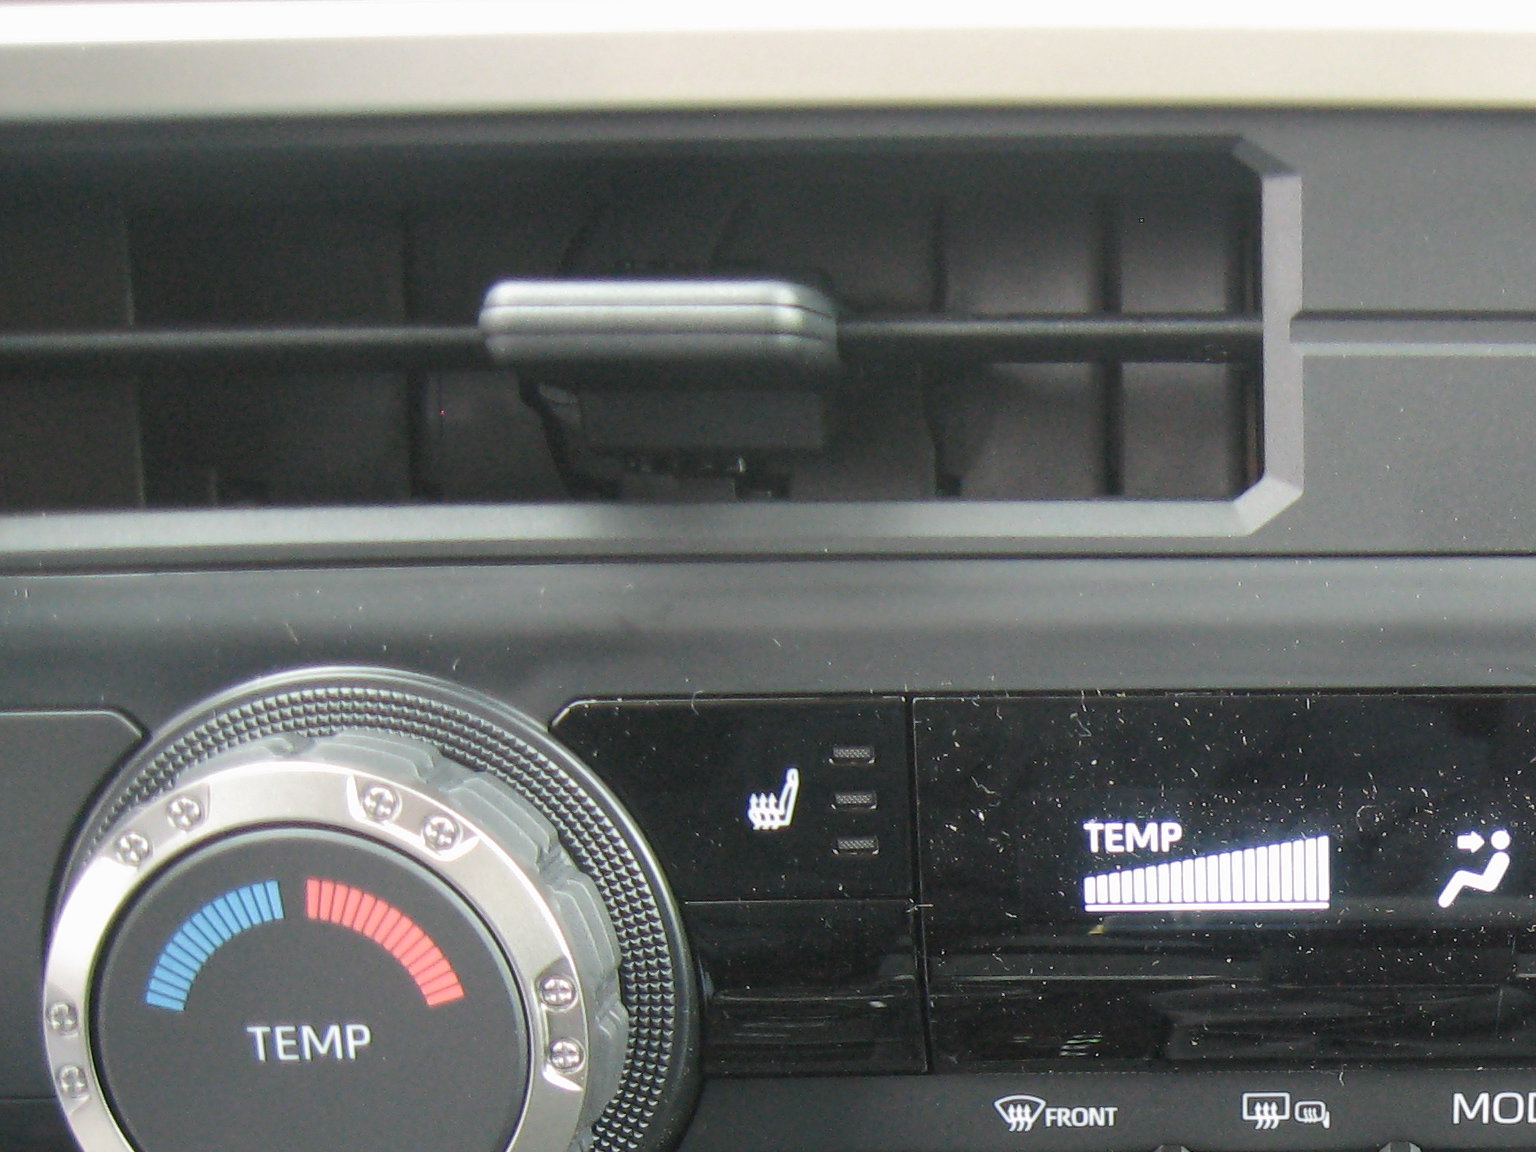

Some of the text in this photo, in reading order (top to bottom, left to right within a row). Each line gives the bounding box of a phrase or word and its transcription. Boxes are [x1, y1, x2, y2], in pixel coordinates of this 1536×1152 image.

[1083, 821, 1183, 853] TEMP
[246, 1023, 372, 1062] TEMP
[1044, 1105, 1118, 1128] FRONT
